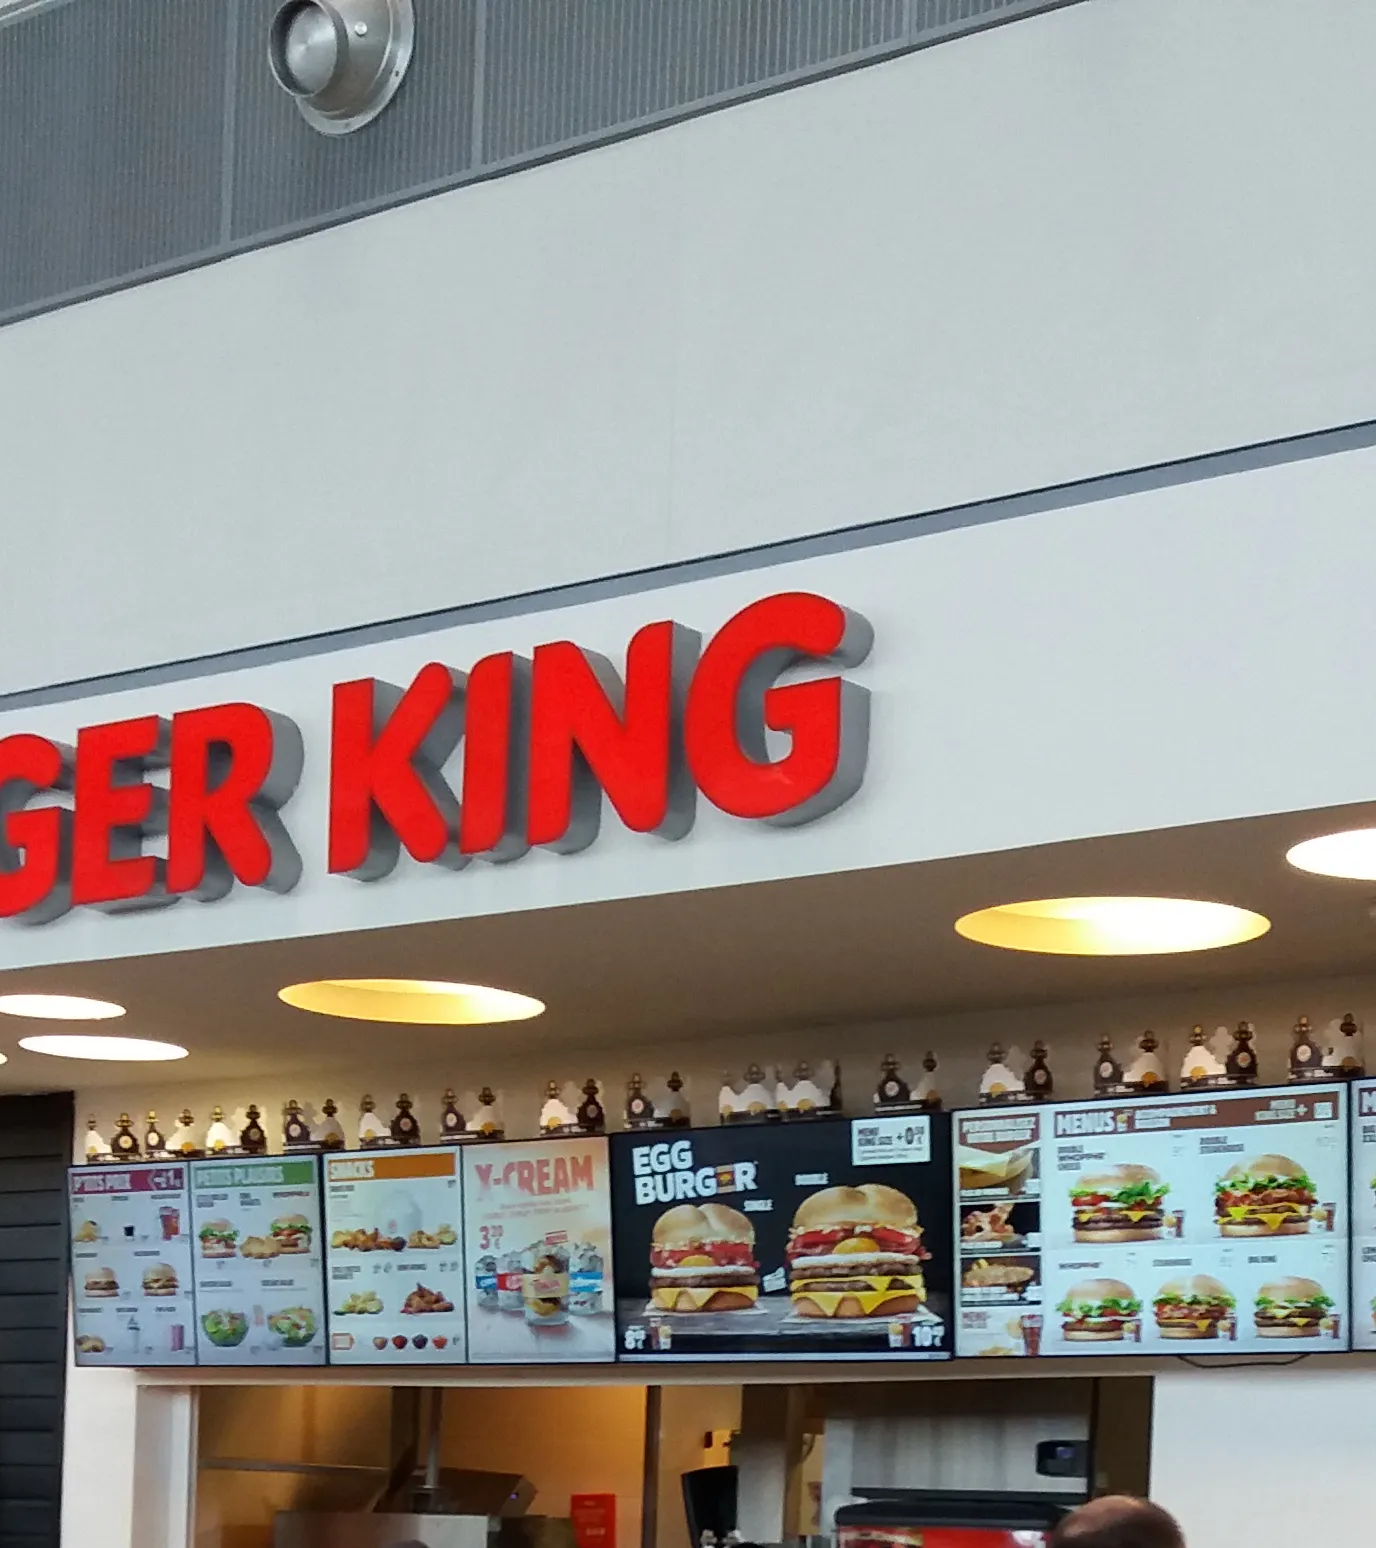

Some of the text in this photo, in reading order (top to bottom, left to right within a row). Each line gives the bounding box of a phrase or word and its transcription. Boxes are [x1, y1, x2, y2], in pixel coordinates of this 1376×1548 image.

[328, 591, 850, 874] KING
[1056, 1111, 1115, 1136] MENUS
[632, 1139, 693, 1176] EGG
